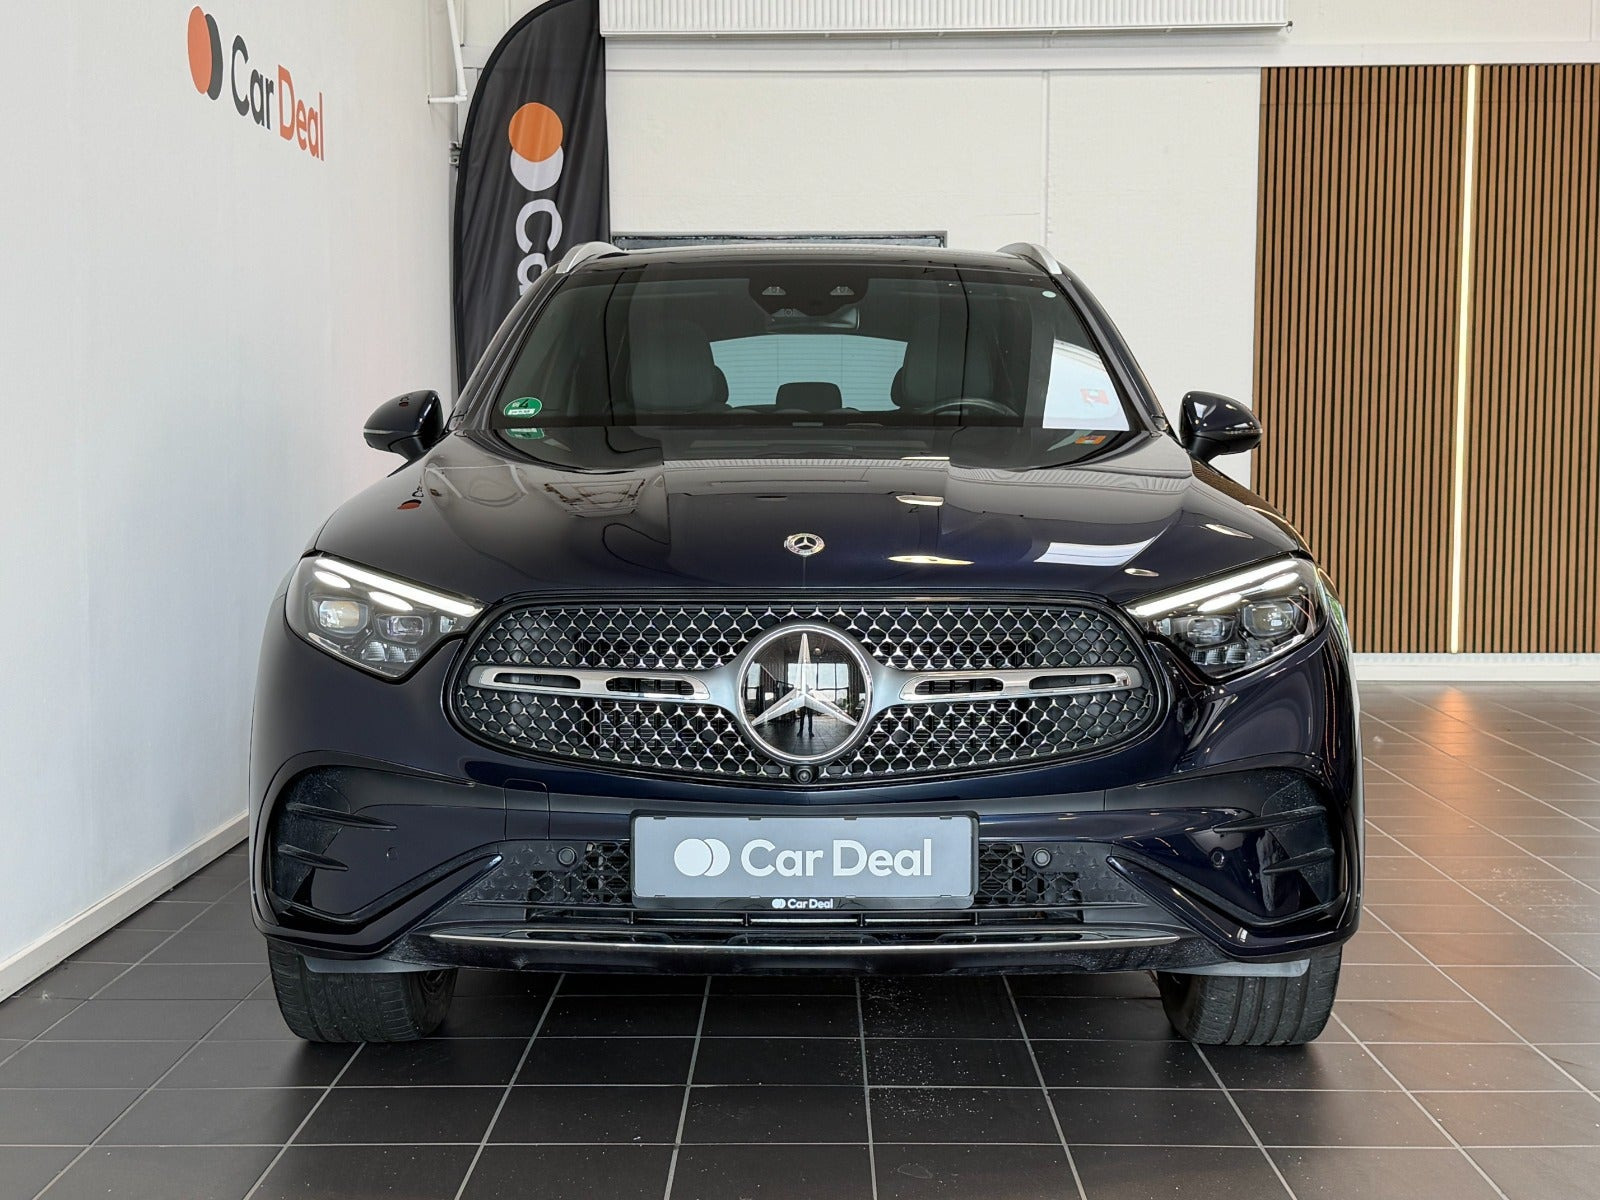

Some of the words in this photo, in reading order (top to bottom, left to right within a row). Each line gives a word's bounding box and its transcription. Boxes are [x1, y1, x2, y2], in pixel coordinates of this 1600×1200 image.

[231, 35, 274, 130] Car
[278, 64, 324, 161] Deal
[740, 839, 823, 877] Car
[833, 838, 932, 877] Deal
[787, 898, 808, 909] Car
[808, 898, 834, 909] Deal
